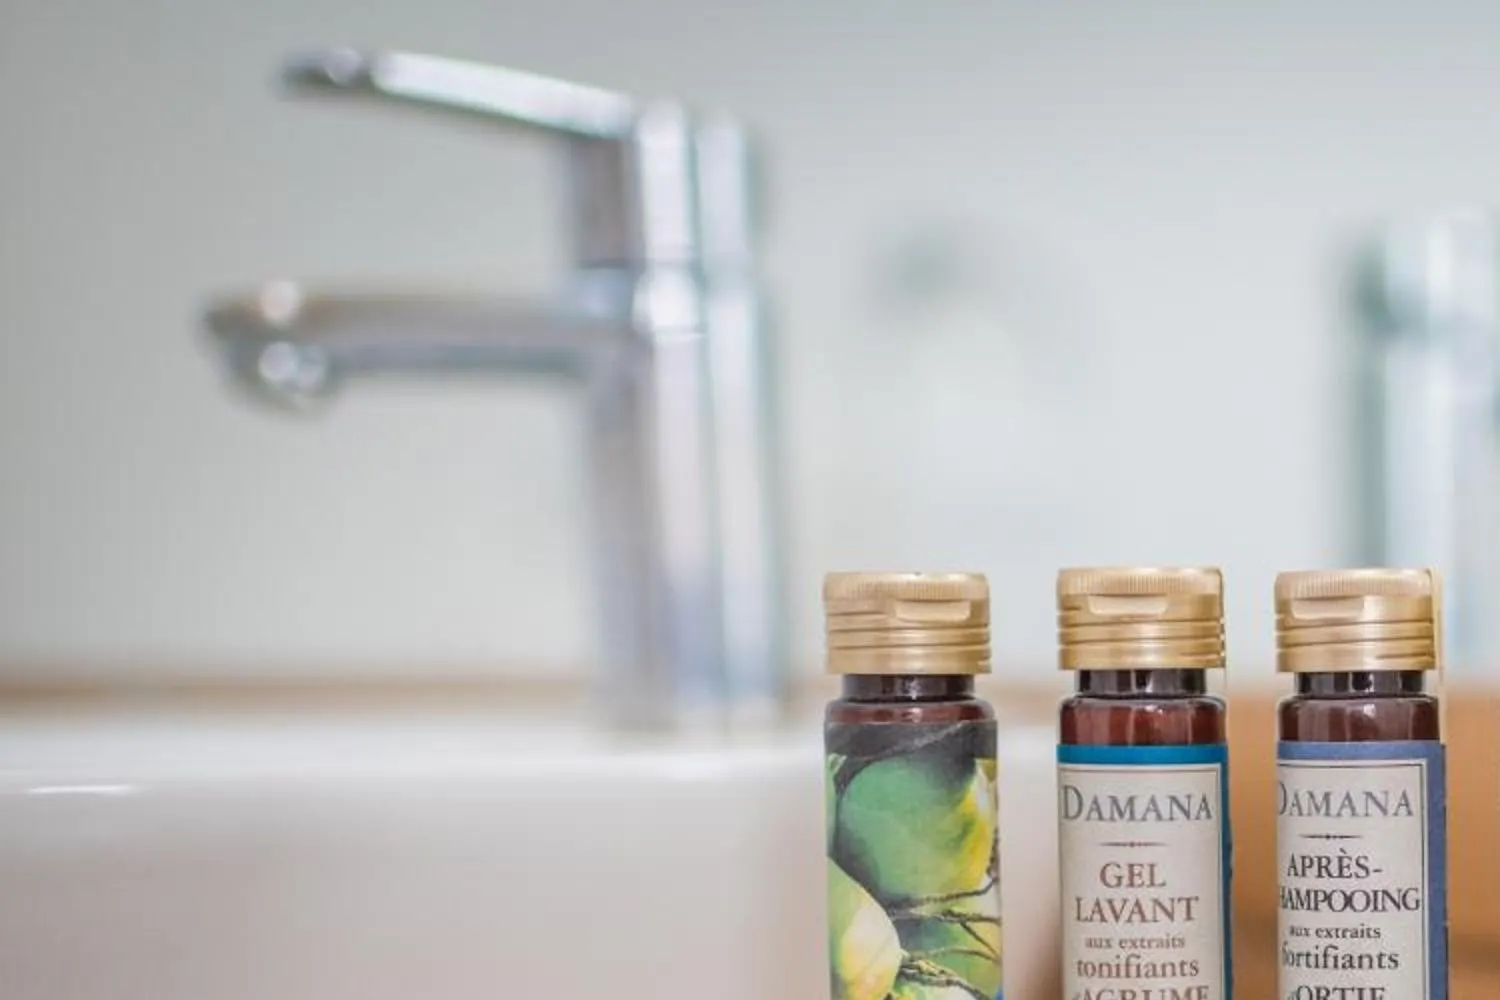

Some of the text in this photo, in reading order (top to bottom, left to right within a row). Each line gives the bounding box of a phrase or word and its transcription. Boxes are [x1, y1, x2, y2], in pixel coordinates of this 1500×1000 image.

[1062, 785, 1214, 822] DAMANA
[1100, 863, 1167, 888] GEL
[1287, 848, 1383, 879] APRÈS-
[1075, 896, 1199, 923] LAVANT
[1085, 932, 1186, 949] aux extraits
[1289, 923, 1382, 939] aux extraits
[1077, 953, 1200, 979] tonifiants
[1281, 940, 1401, 970] fortifiants
